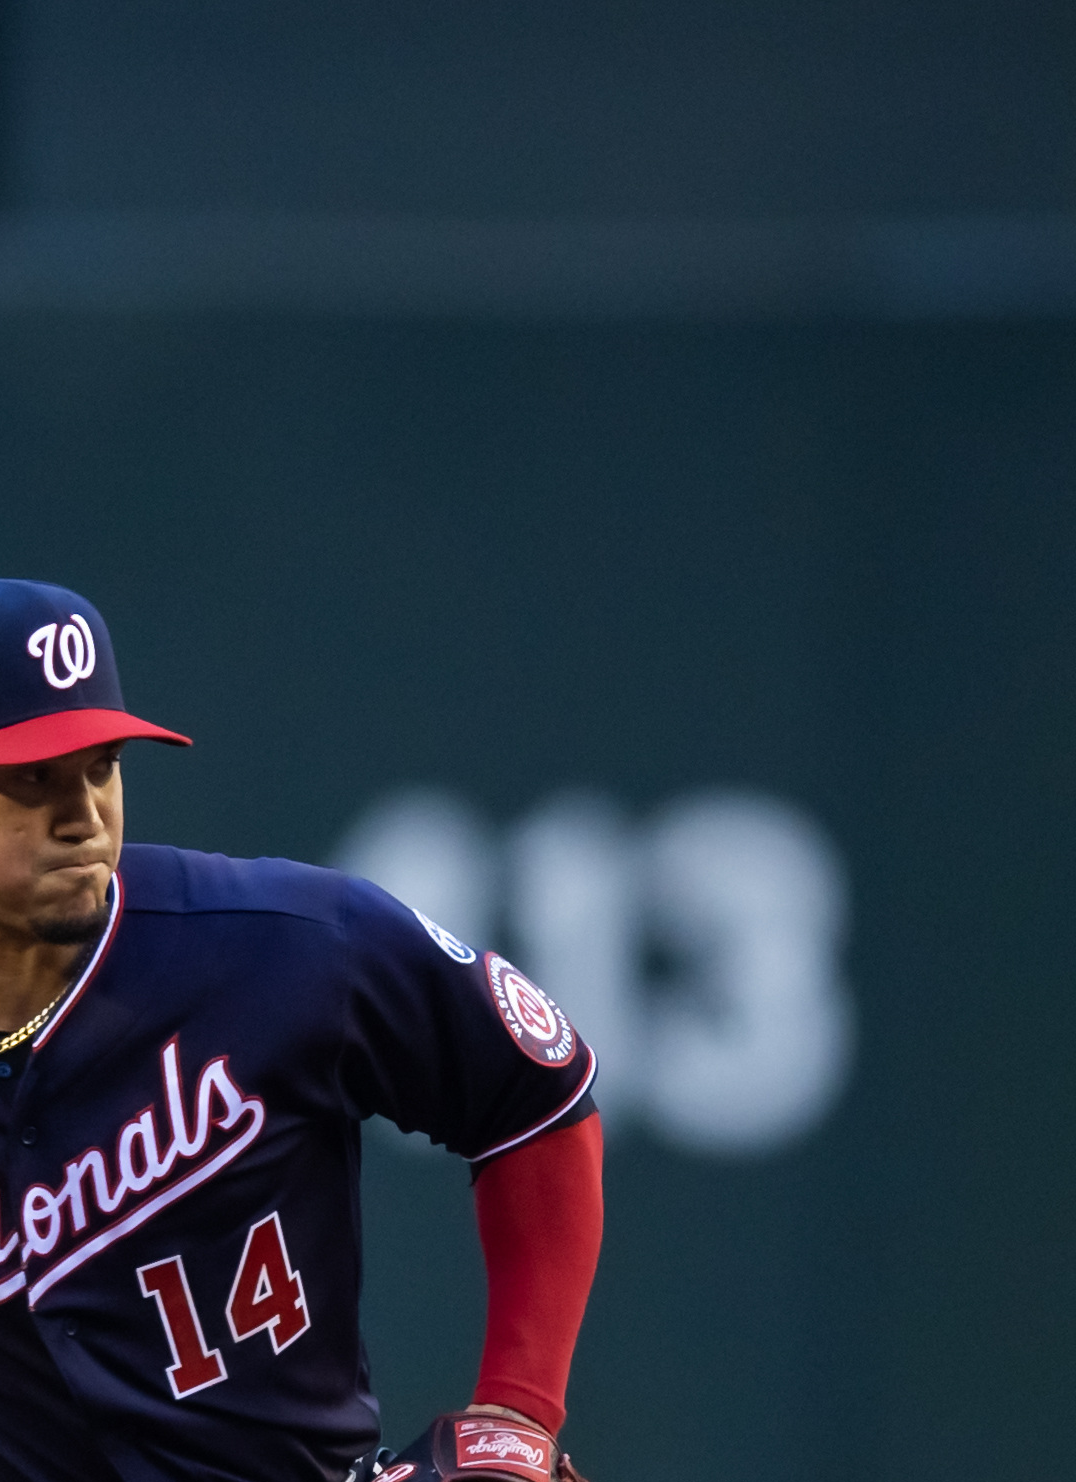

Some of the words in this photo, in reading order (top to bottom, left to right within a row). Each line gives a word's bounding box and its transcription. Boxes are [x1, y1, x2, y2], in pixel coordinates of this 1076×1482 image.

[26, 612, 96, 690] W
[490, 956, 523, 1039] WASHING
[136, 1210, 312, 1400] 14
[465, 1434, 544, 1467] Rawlings
